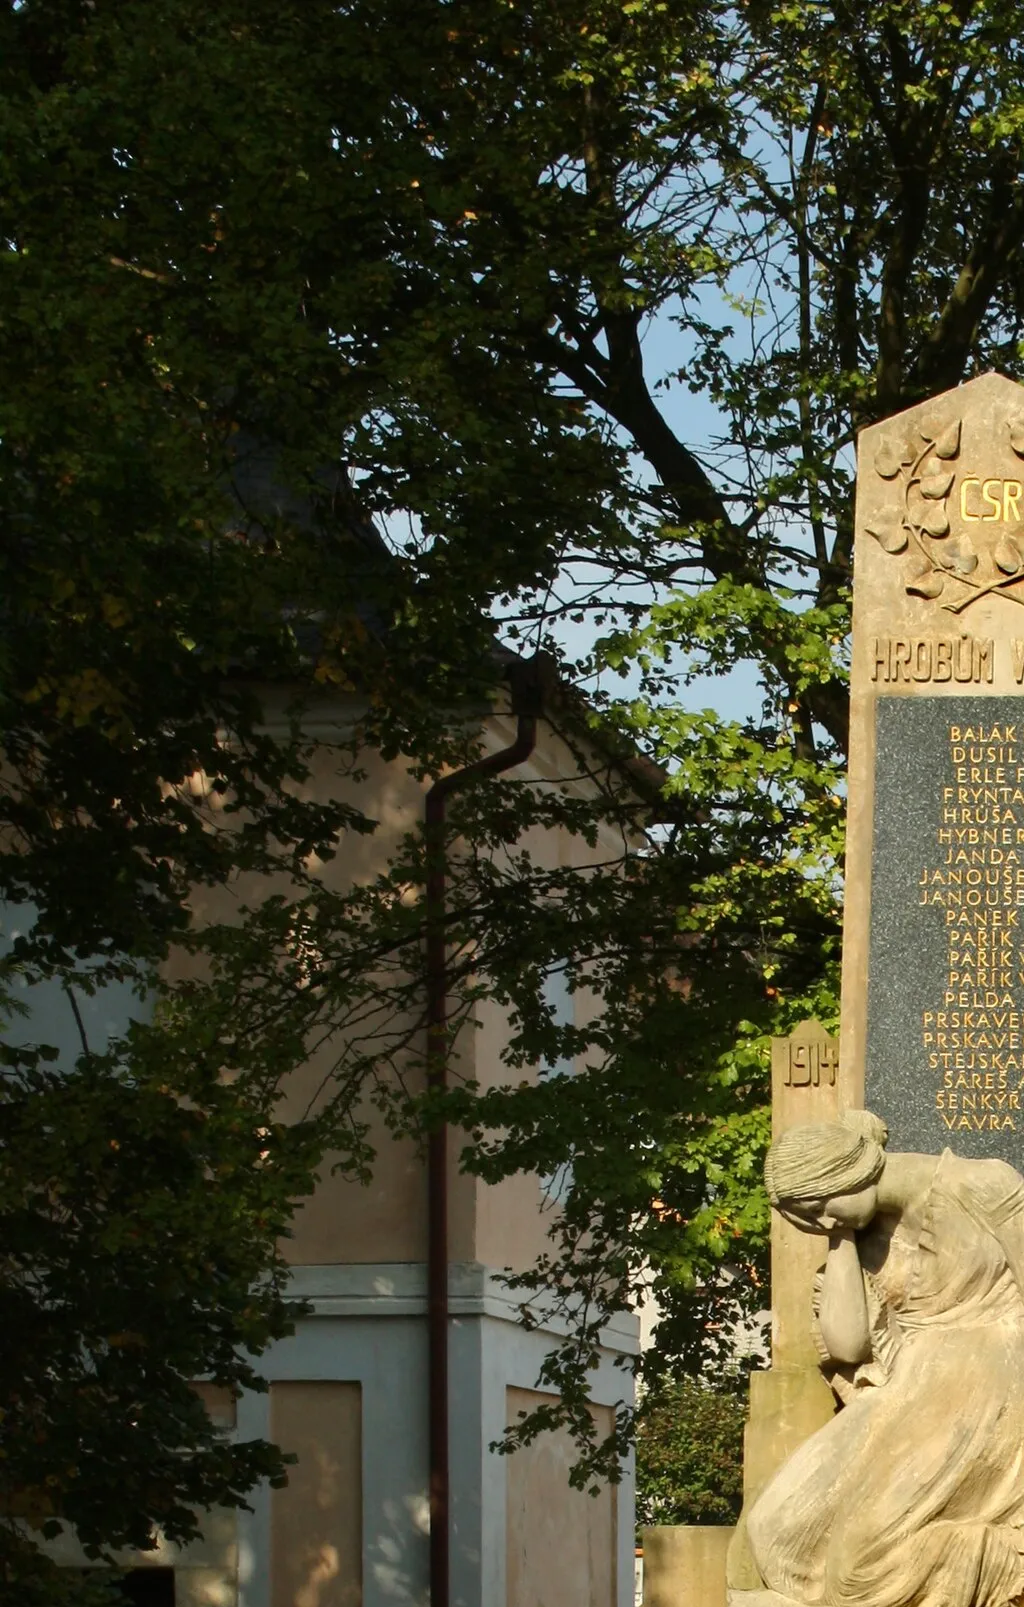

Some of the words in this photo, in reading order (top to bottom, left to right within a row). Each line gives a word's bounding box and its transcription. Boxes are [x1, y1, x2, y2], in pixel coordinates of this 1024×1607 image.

[960, 471, 1023, 522] ČSR
[870, 634, 994, 683] HROBŮM
[950, 722, 1017, 743] BALÁK
[952, 747, 1017, 763] DUSIL
[957, 768, 1006, 783] ERLE
[944, 849, 1020, 864] JANDA
[946, 906, 1018, 926] PÁNEK
[949, 928, 1014, 946] PAŘÍK
[949, 948, 1014, 967] PAŘÍK
[948, 968, 1014, 987] PAŘÍK
[944, 992, 1015, 1008] PELDA
[943, 1070, 1008, 1089] ŠÁREŠ
[935, 1090, 1021, 1110] ŠENKÝŘ
[942, 1111, 1016, 1130] VÁVRA
